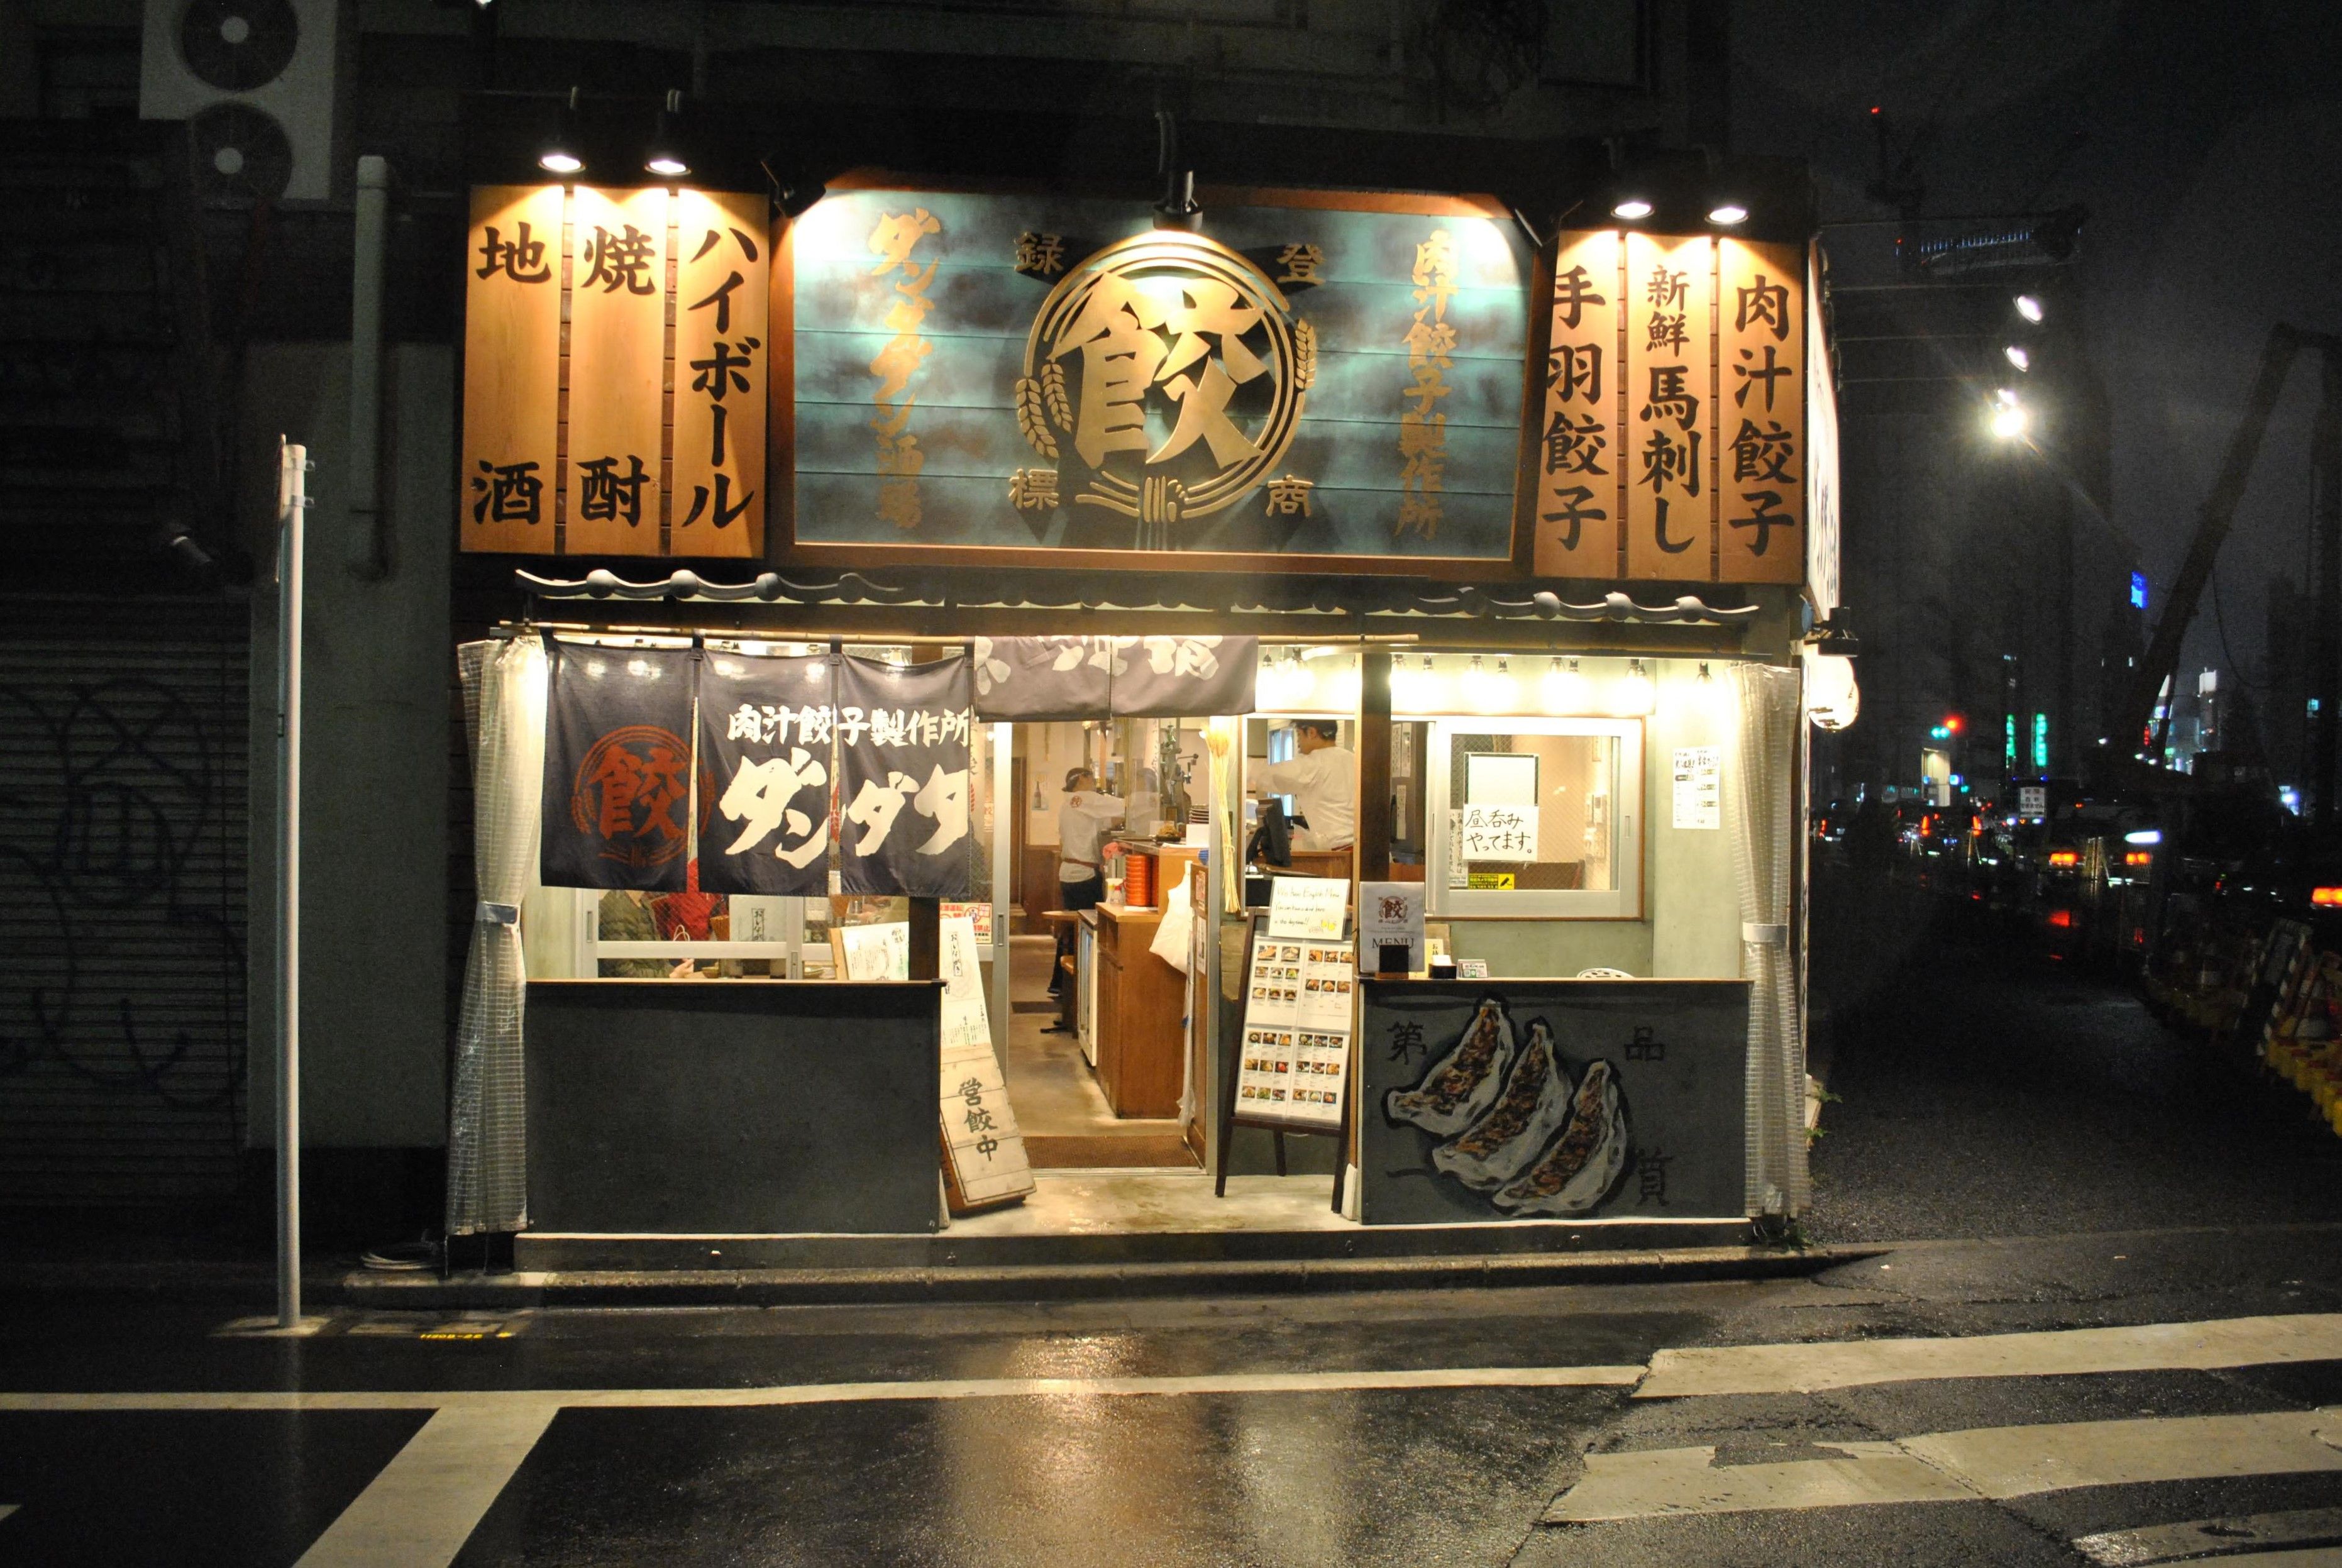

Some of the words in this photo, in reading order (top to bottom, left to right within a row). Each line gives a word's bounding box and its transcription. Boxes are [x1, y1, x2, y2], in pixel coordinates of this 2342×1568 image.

[473, 222, 552, 524] 地酒
[576, 224, 656, 527] 焼酎
[682, 228, 761, 528] ハイボール
[1048, 272, 1271, 469] 餃
[1393, 229, 1461, 539] 肉汁餃子製作所
[1542, 265, 1609, 551] 手羽餃子
[1638, 264, 1699, 553] 新鮮馬刺し
[1728, 274, 1798, 558] 肉汁餃子
[727, 703, 969, 748] 肉汁餃子製作所
[1465, 810, 1524, 830] 昼呑み
[958, 1077, 997, 1162] 営餃中
